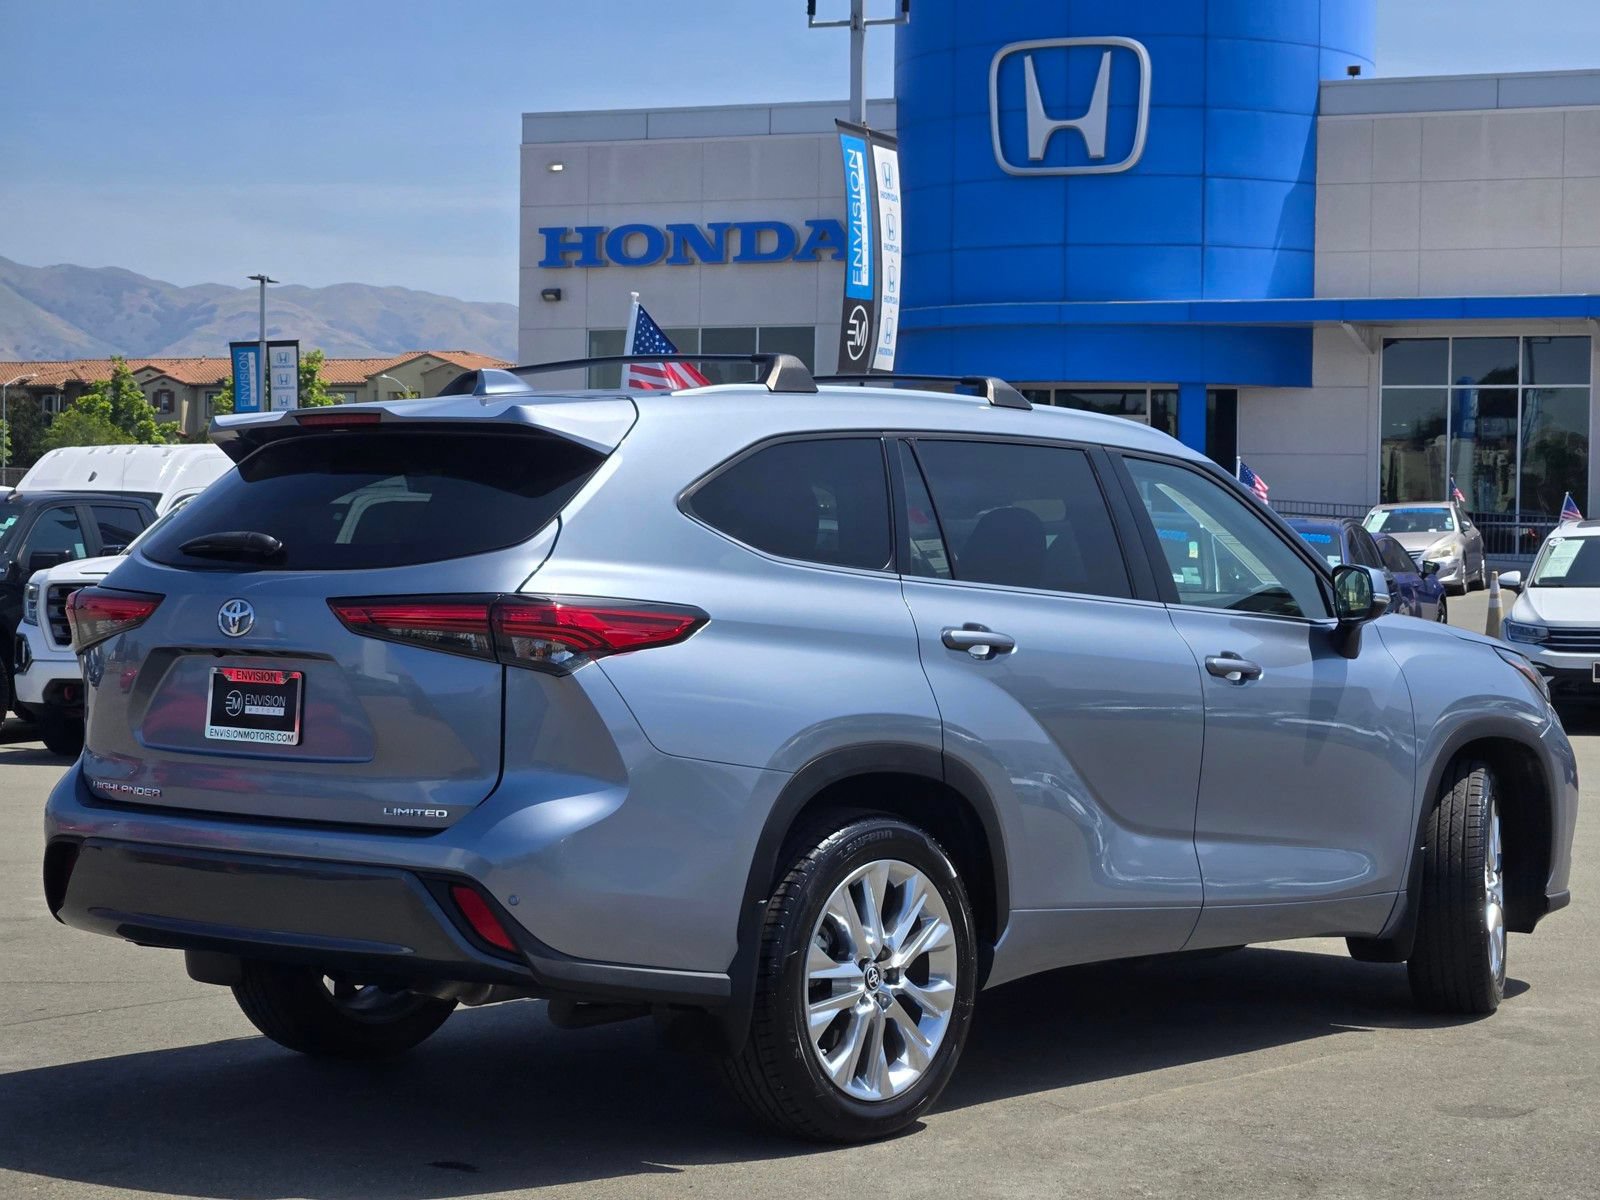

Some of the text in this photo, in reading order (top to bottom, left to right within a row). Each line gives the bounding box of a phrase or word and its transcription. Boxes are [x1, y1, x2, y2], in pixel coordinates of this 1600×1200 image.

[847, 149, 863, 285] ENVISION
[538, 219, 846, 267] HONDA
[239, 352, 249, 407] ENVISION
[236, 671, 277, 682] ENVISION
[245, 694, 286, 707] ENVISION
[210, 728, 294, 742] ENVISIONMOTORS.COM
[93, 781, 161, 797] HIGHLANDER
[383, 807, 448, 819] LIMITED
